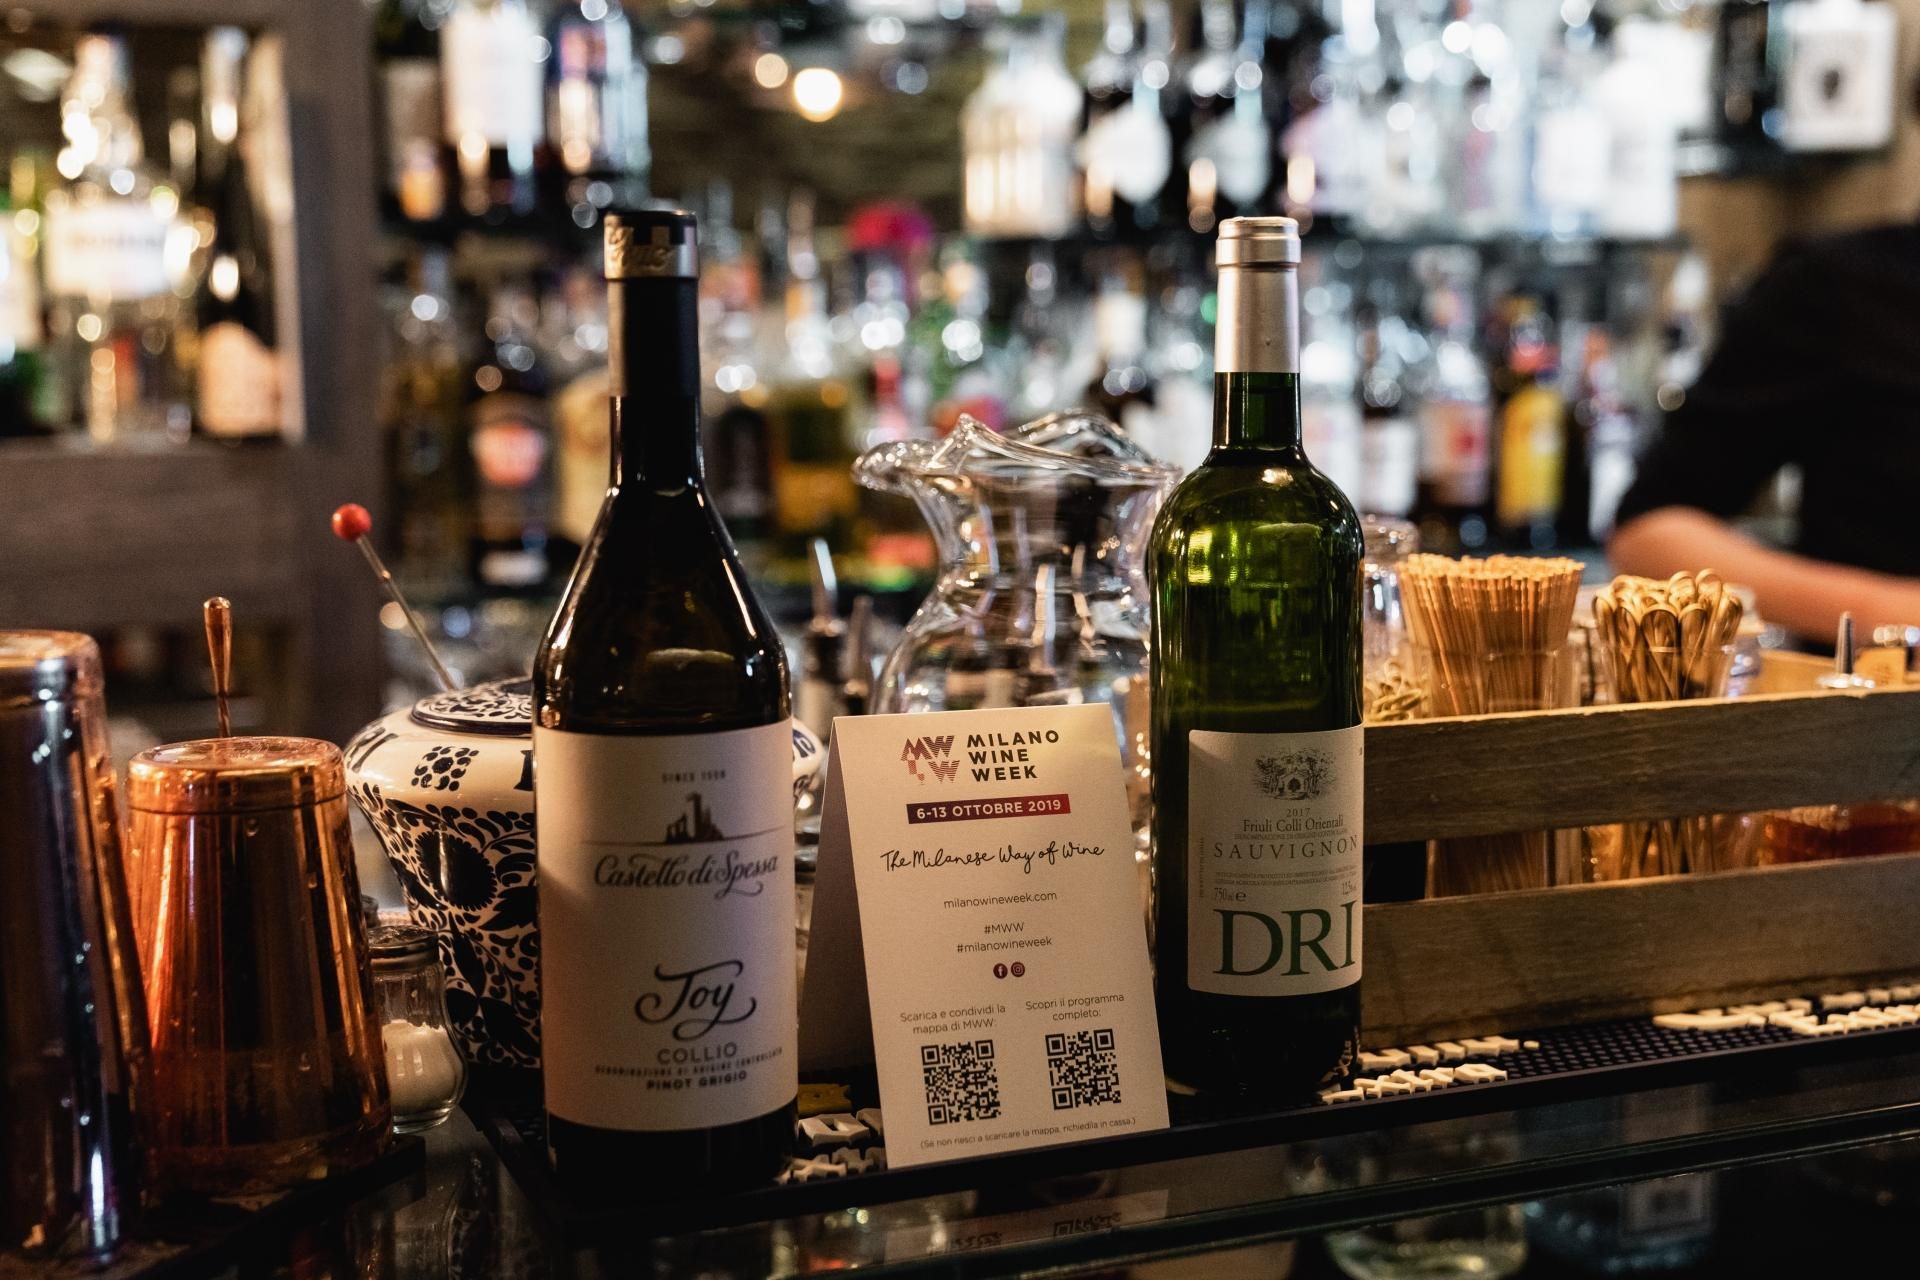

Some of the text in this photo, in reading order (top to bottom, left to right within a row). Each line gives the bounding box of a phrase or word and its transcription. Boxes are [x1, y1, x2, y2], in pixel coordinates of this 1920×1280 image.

[966, 730, 1060, 748] MILANO
[968, 748, 1029, 765] WINE
[971, 765, 1038, 782] WEEK
[916, 799, 1061, 820] 6-13 OTTOBRE 2019
[1286, 807, 1311, 818] 2017
[1243, 815, 1344, 832] Friuli Colli Orientali
[1213, 834, 1358, 860] SAUVIGNON
[880, 840, 1105, 874] The Milanese Way of Wine
[595, 850, 778, 899] Castello di Spessa
[943, 891, 1058, 910] milanowineweek.com
[983, 921, 1025, 934] #MWW
[956, 936, 1053, 953] #milanowineweek
[1212, 900, 1358, 976] DRI
[633, 958, 758, 1042] Joy
[1025, 993, 1125, 1011] Scopri il programma
[900, 1003, 1006, 1022] Scarica e condividi la
[1052, 1008, 1102, 1021] completo:
[912, 1023, 949, 1035] mappa
[951, 1020, 961, 1031] di
[657, 1041, 738, 1066] COLLIO
[646, 1070, 748, 1092] PINOT GRIGIO
[937, 1137, 952, 1147] non
[978, 1135, 983, 1143] a
[985, 1130, 1021, 1141] scaricare
[1022, 1128, 1030, 1137] la
[1063, 1121, 1098, 1133] richiedila
[1100, 1120, 1108, 1129] in
